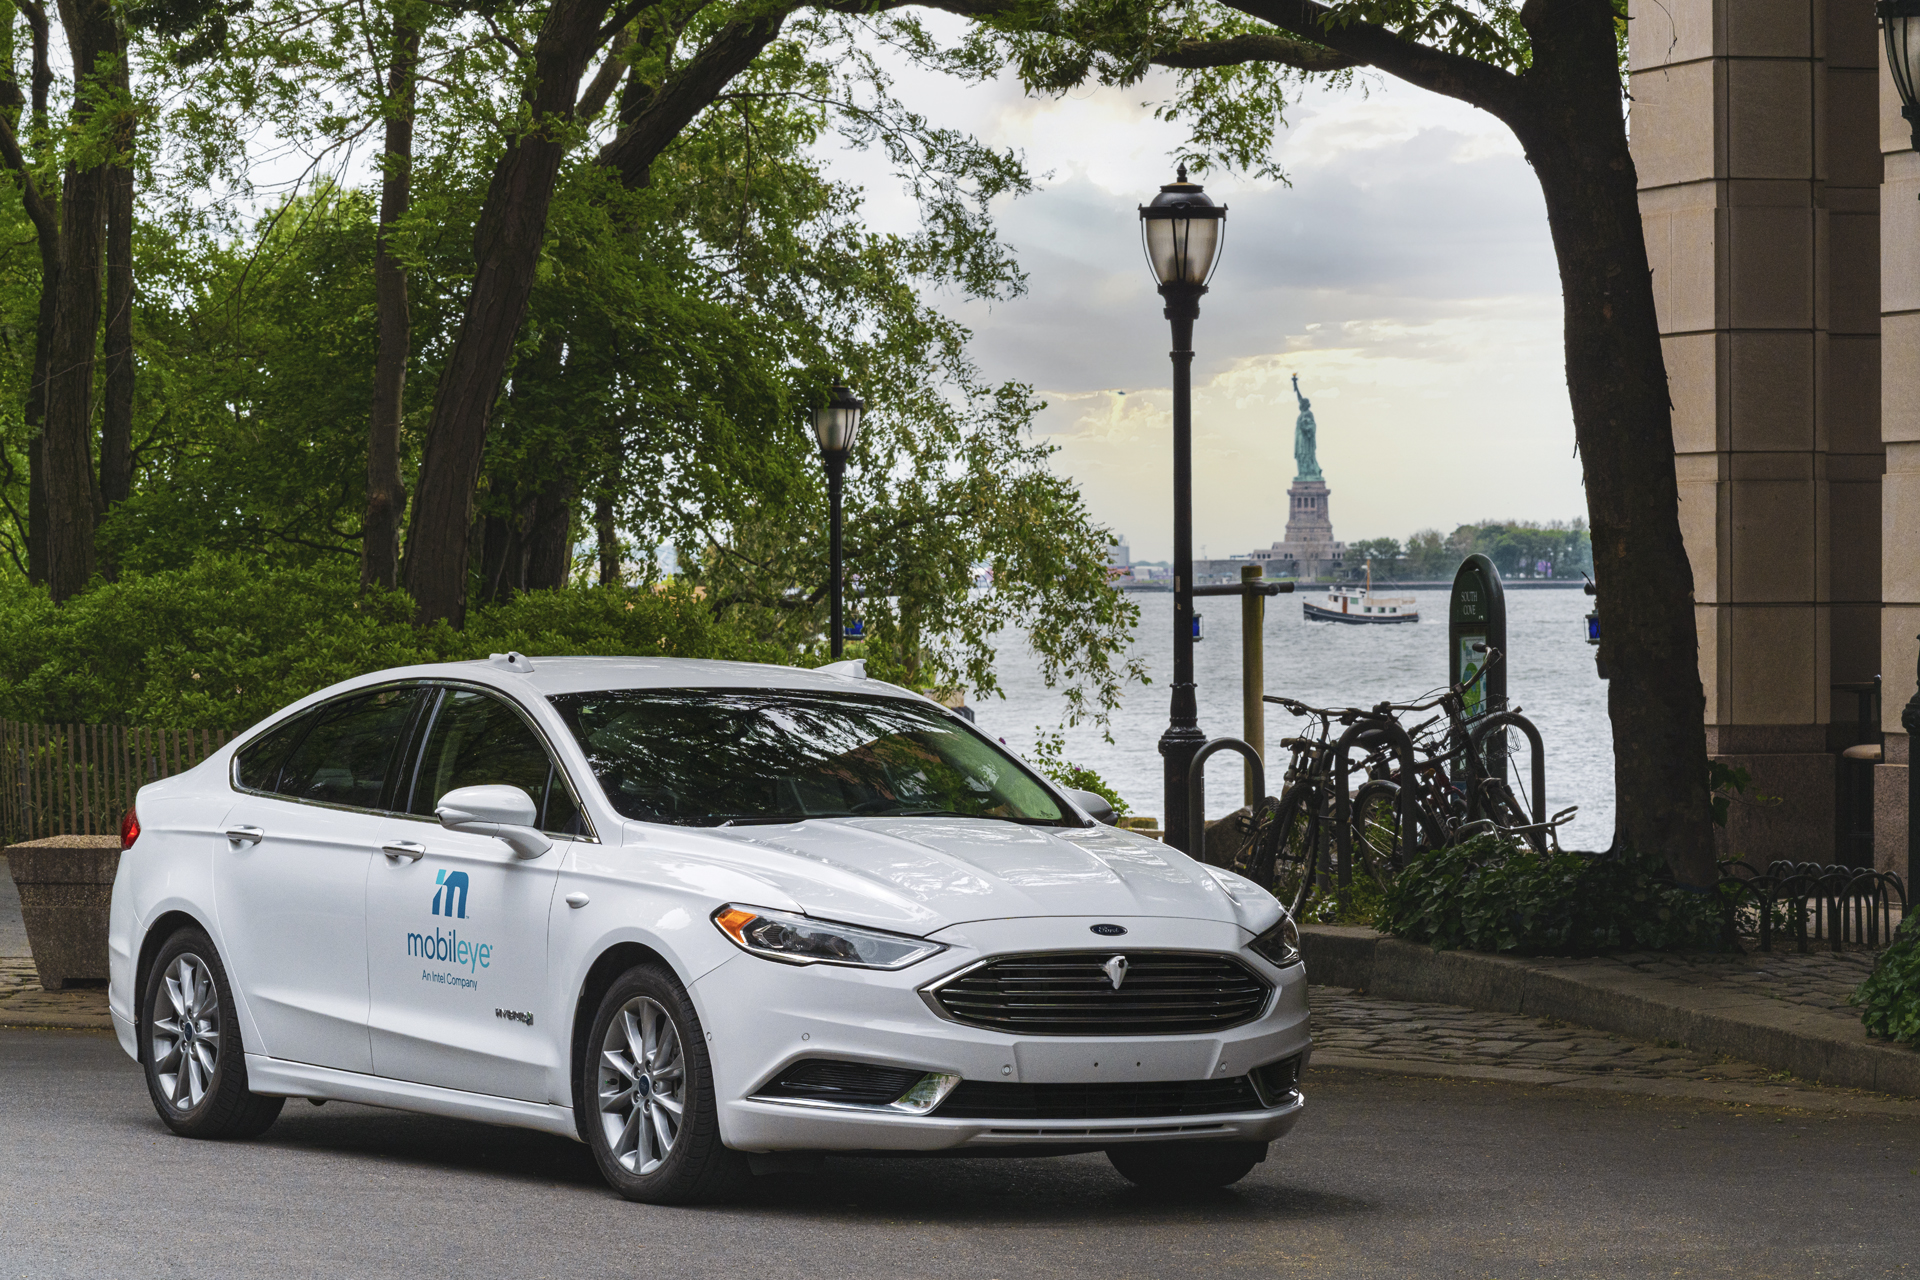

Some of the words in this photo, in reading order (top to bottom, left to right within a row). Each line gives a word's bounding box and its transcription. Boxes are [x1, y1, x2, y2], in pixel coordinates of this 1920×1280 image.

[407, 927, 493, 974] mobileye
[422, 970, 431, 982] An
[432, 971, 446, 984] Intel
[446, 973, 478, 991] Company
